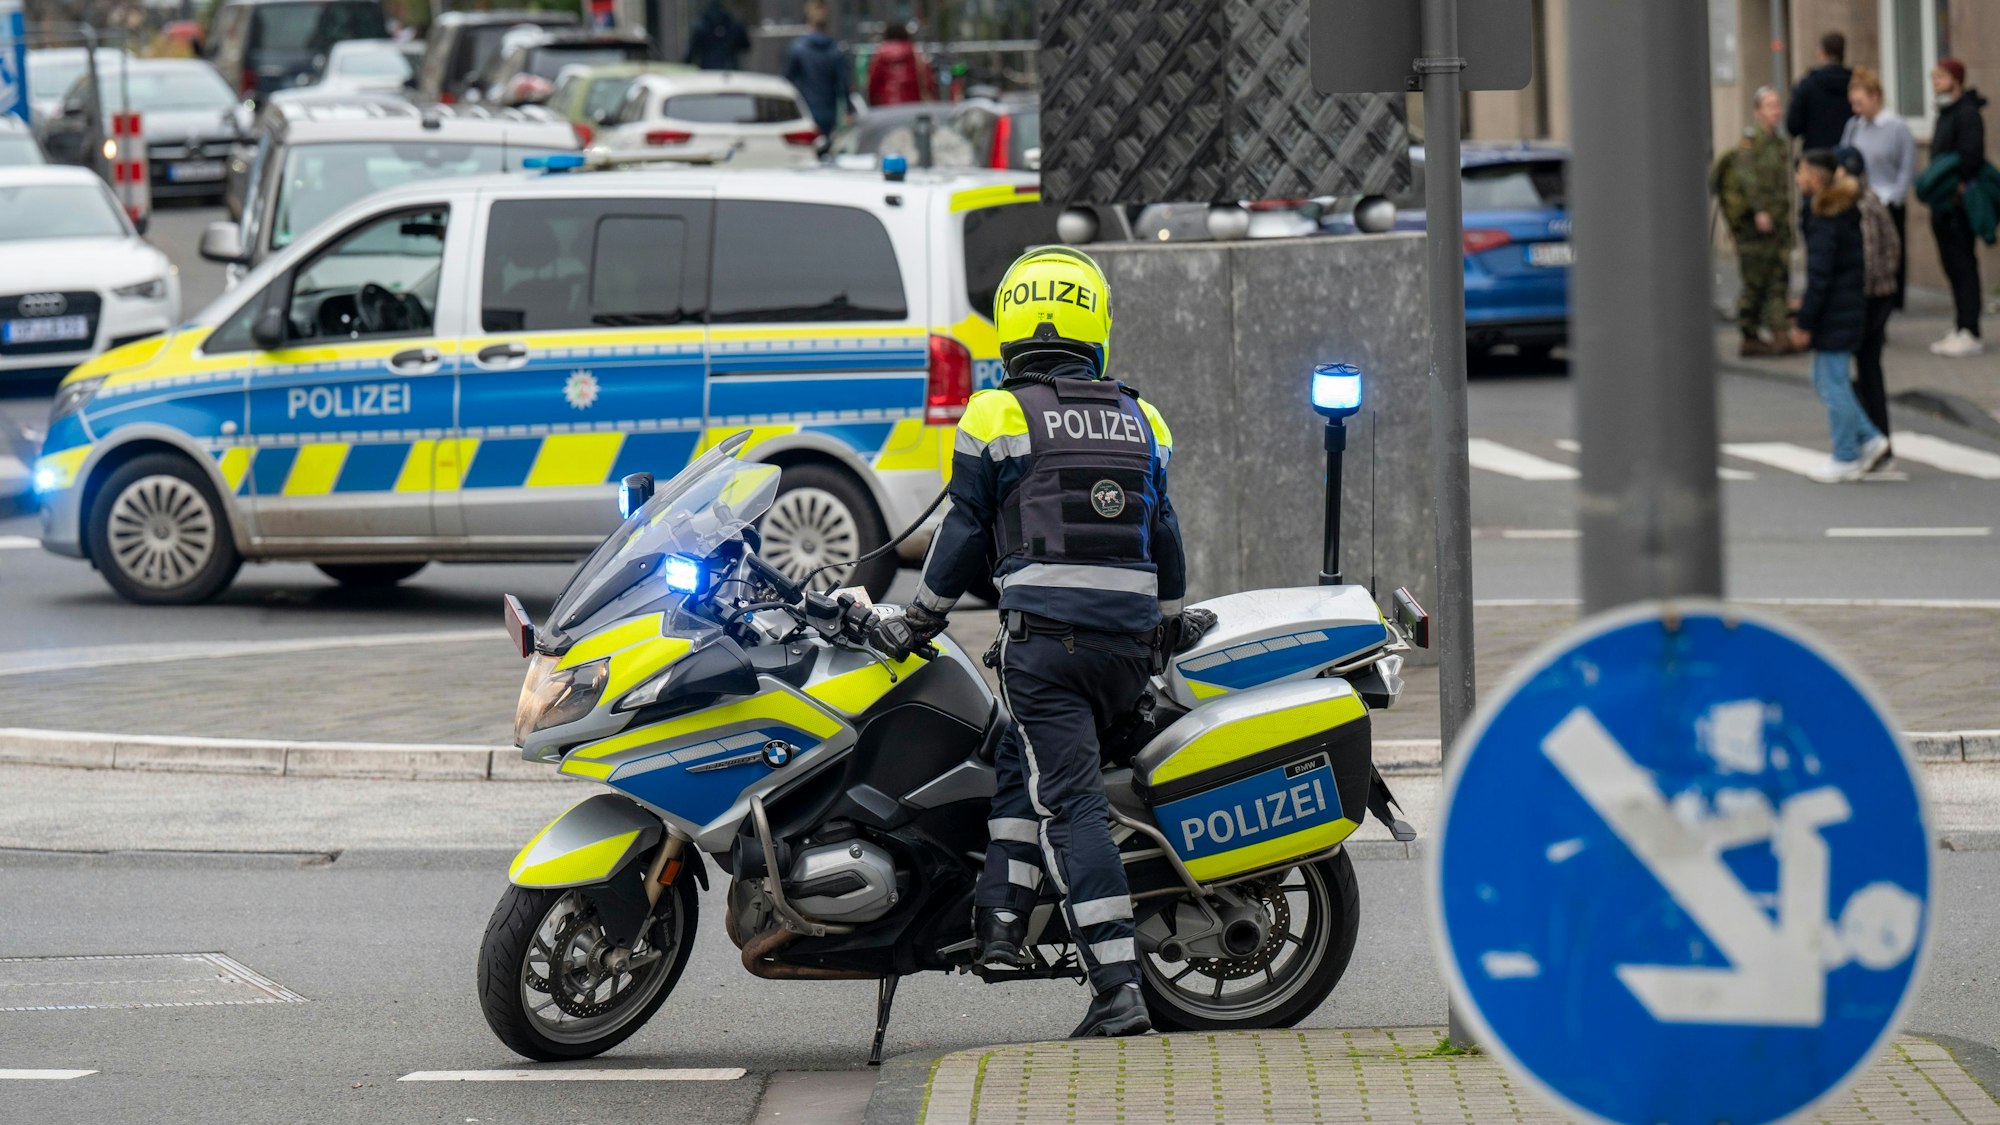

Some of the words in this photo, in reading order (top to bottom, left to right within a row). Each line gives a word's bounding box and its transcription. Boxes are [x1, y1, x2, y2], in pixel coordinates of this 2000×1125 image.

[1003, 280, 1097, 313] POLIZEI
[975, 361, 1009, 389] PO
[287, 382, 411, 420] POLIZEI
[1043, 409, 1147, 444] POLIZEI
[1294, 760, 1316, 774] BMW
[1180, 778, 1327, 852] POLIZEI
